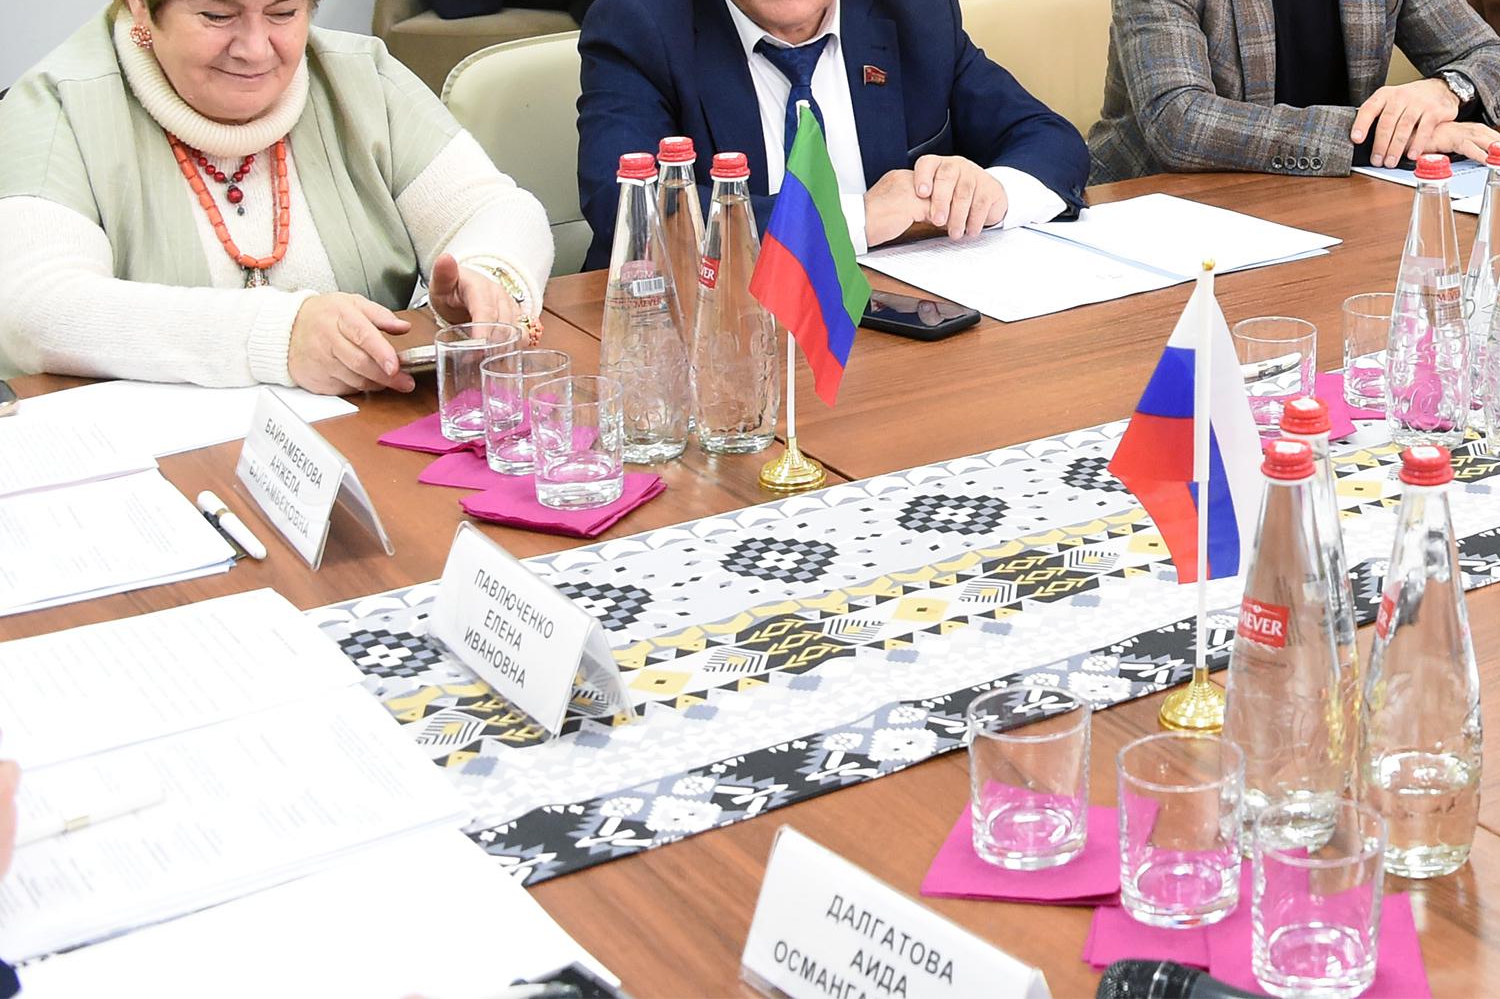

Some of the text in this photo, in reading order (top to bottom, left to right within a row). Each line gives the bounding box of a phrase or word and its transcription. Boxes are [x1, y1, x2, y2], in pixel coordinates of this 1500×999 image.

[264, 418, 323, 489] БАЙРАМБЕКОВА
[269, 454, 301, 498] АНЖЕЛА
[474, 568, 554, 640] ПАВЛЮЧЕНКО
[483, 608, 523, 652] ЕЛЕНА
[463, 624, 527, 690] ИВАНОВНА
[826, 894, 955, 986] ДАЛГАТОВА
[849, 948, 909, 999] АИДА
